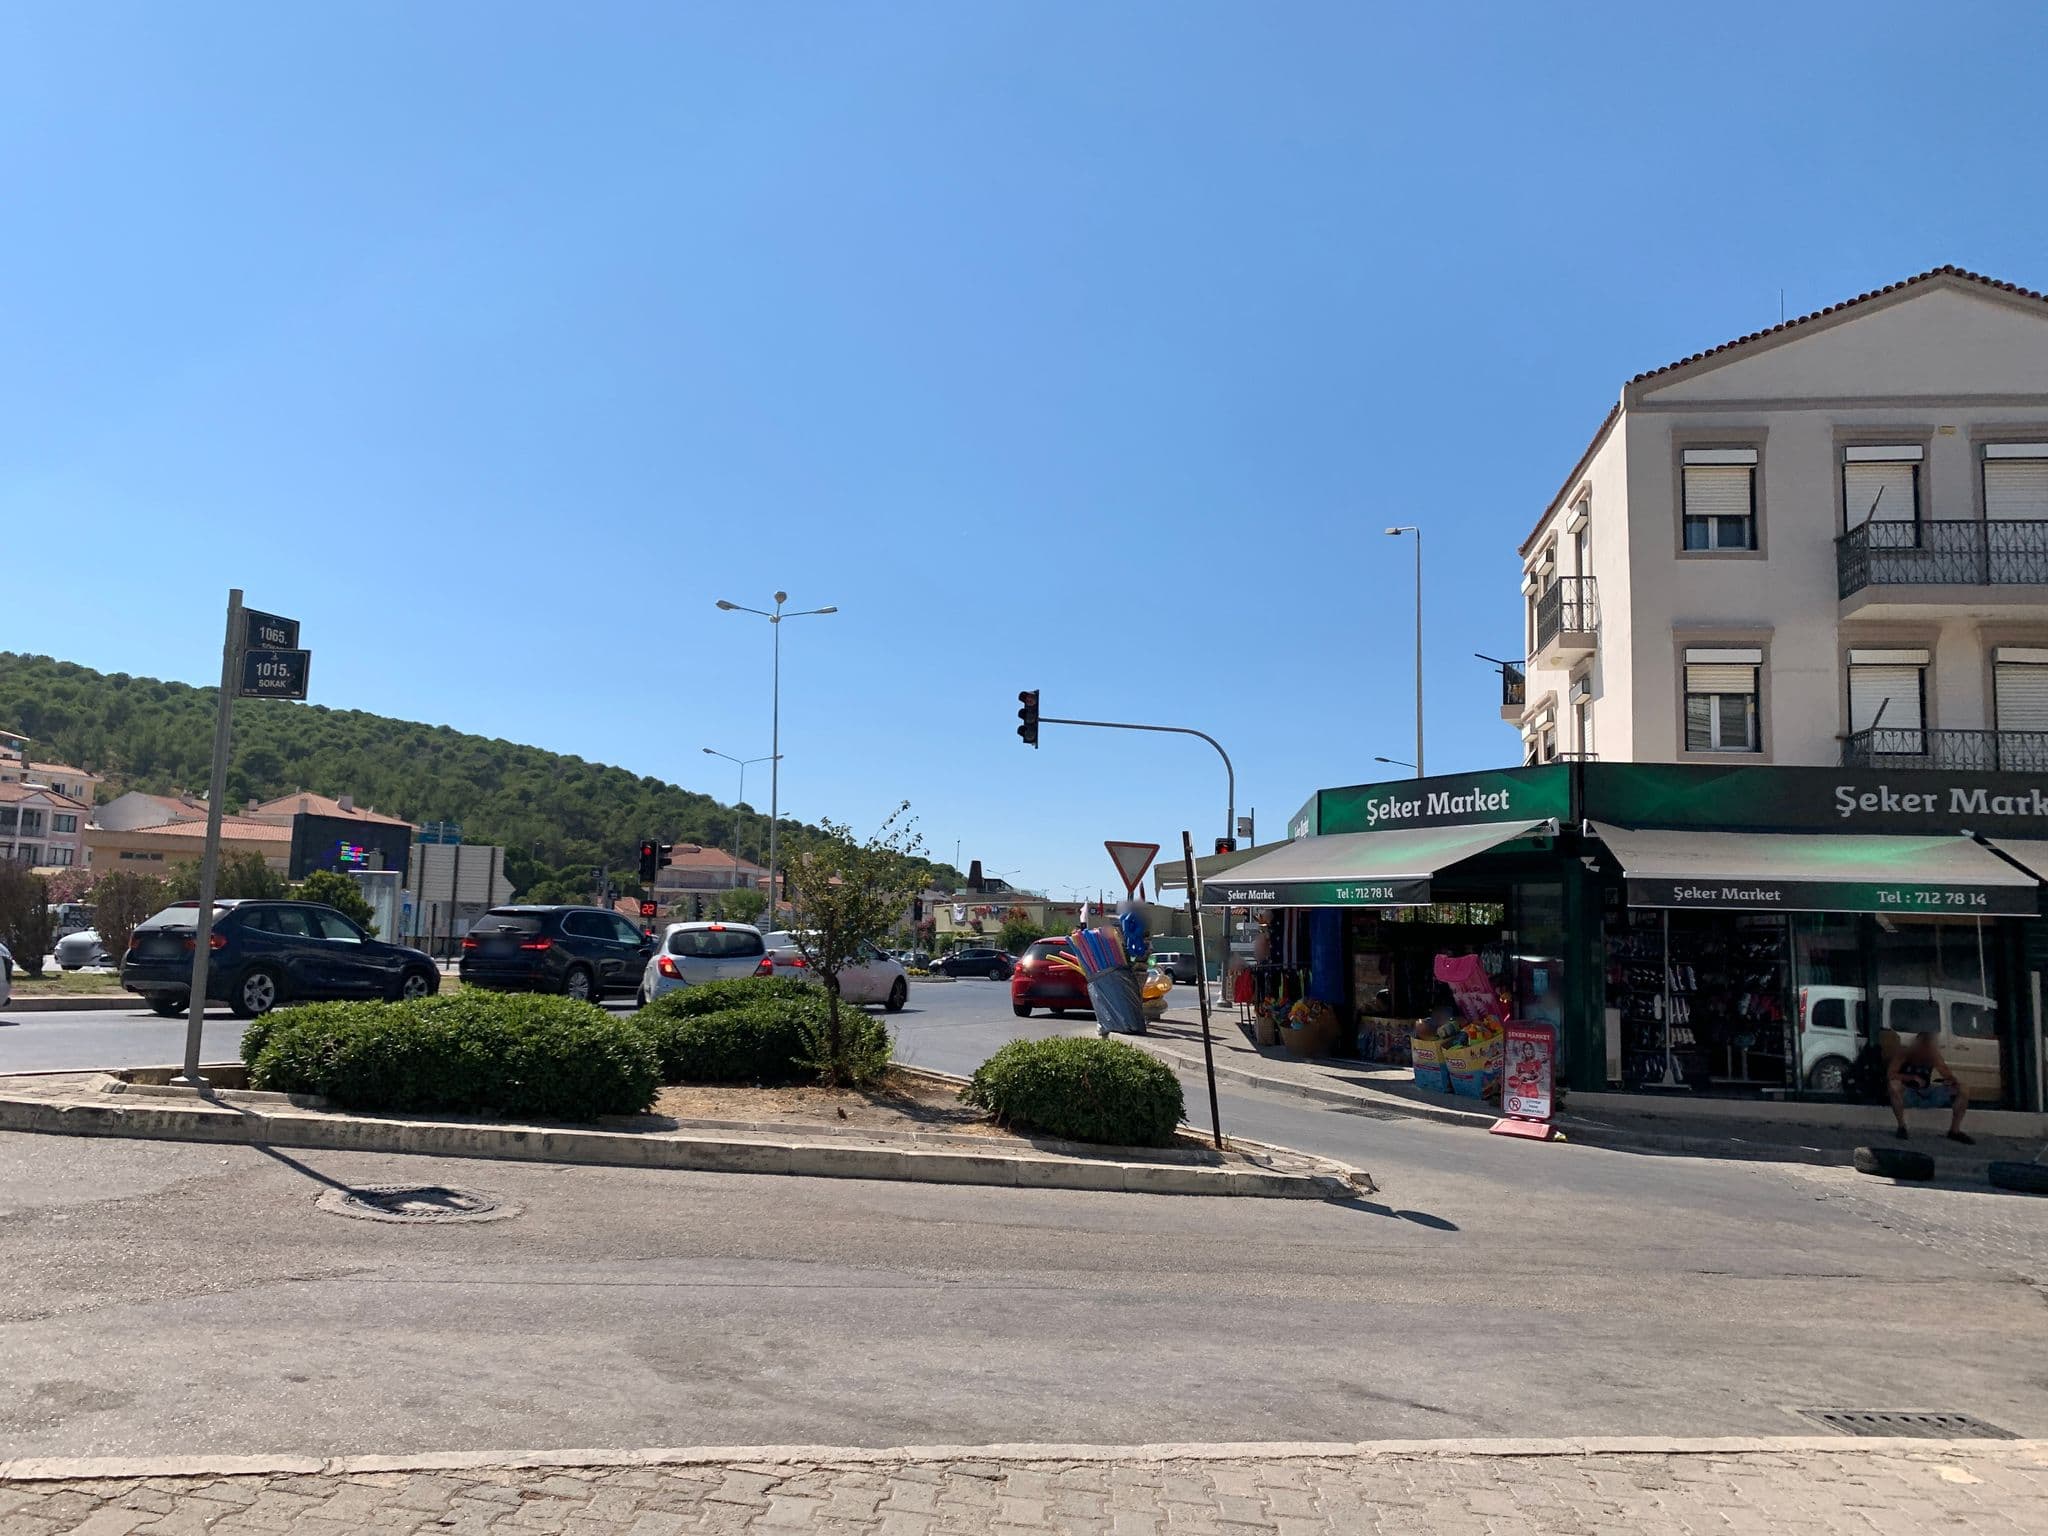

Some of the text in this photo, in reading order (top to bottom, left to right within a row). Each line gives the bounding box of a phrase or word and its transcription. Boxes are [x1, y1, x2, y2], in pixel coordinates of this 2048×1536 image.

[259, 626, 288, 645] 1065.
[256, 662, 290, 677] 1015.
[258, 679, 287, 688] SOKAK
[1366, 787, 1510, 826] Şeker Market
[1835, 785, 1938, 817] Şeker
[1227, 889, 1247, 901] Şeker
[1248, 889, 1275, 900] Market
[1355, 888, 1369, 898] 712
[1371, 888, 1382, 898] 78
[1383, 887, 1393, 898] 14
[1673, 885, 1718, 902] Şeker
[1721, 887, 1781, 902] Market
[1915, 891, 1941, 905] 712
[1945, 892, 1965, 905] 78
[1969, 892, 1987, 906] 14
[642, 904, 655, 914] 22
